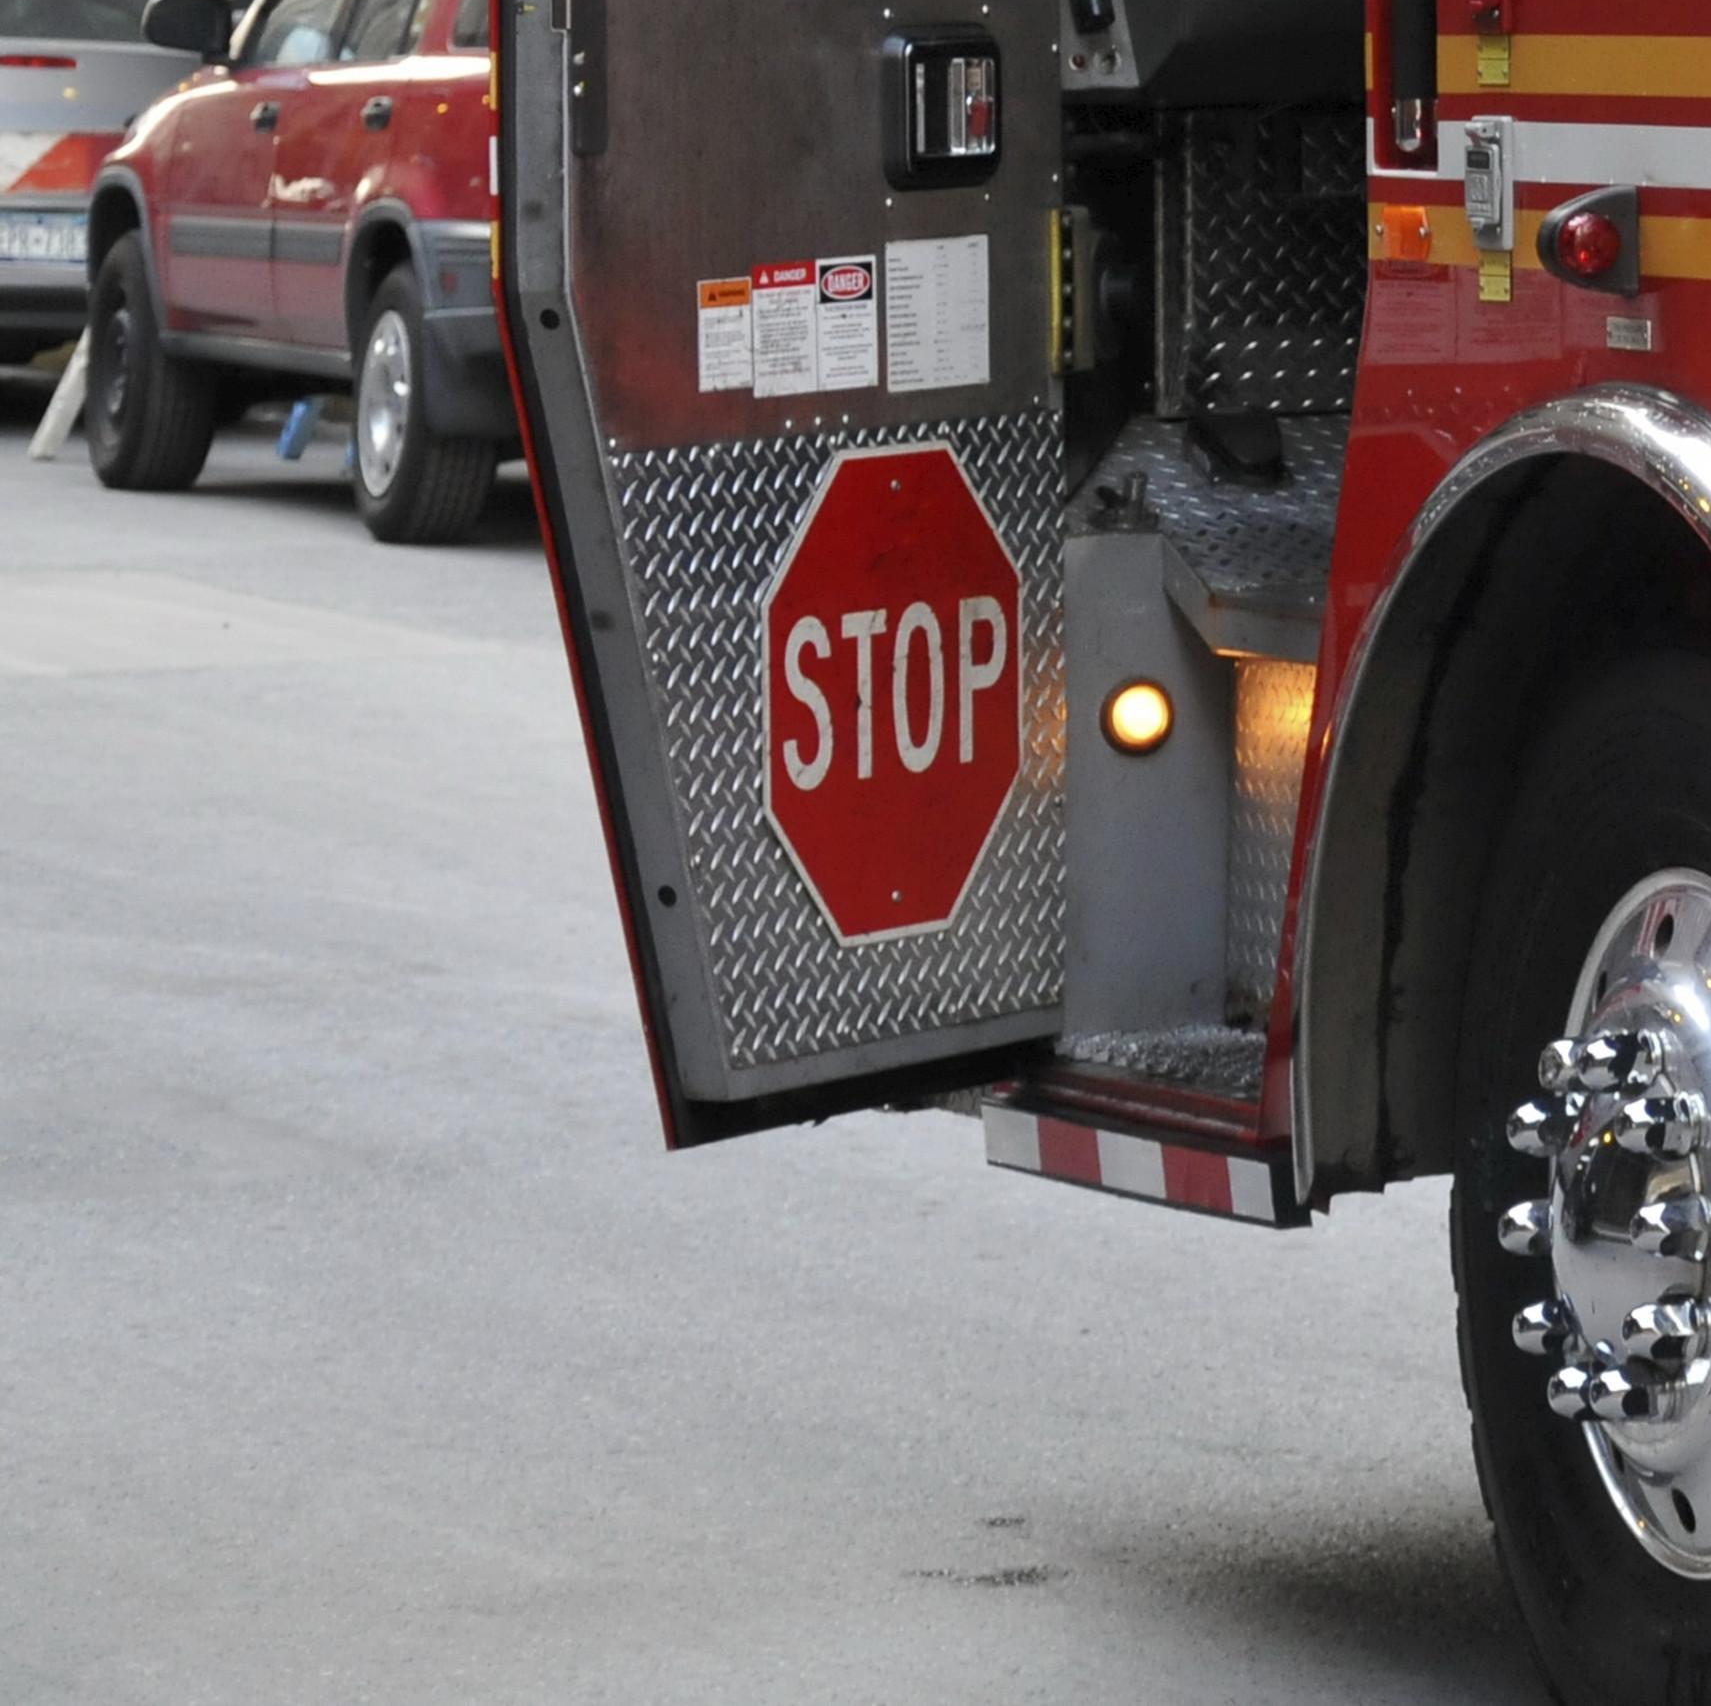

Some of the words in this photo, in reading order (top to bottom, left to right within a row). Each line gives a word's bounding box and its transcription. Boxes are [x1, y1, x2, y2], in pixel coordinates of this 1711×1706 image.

[773, 267, 807, 283] DANGER
[827, 271, 865, 293] DANGER
[782, 595, 1007, 791] STOP
